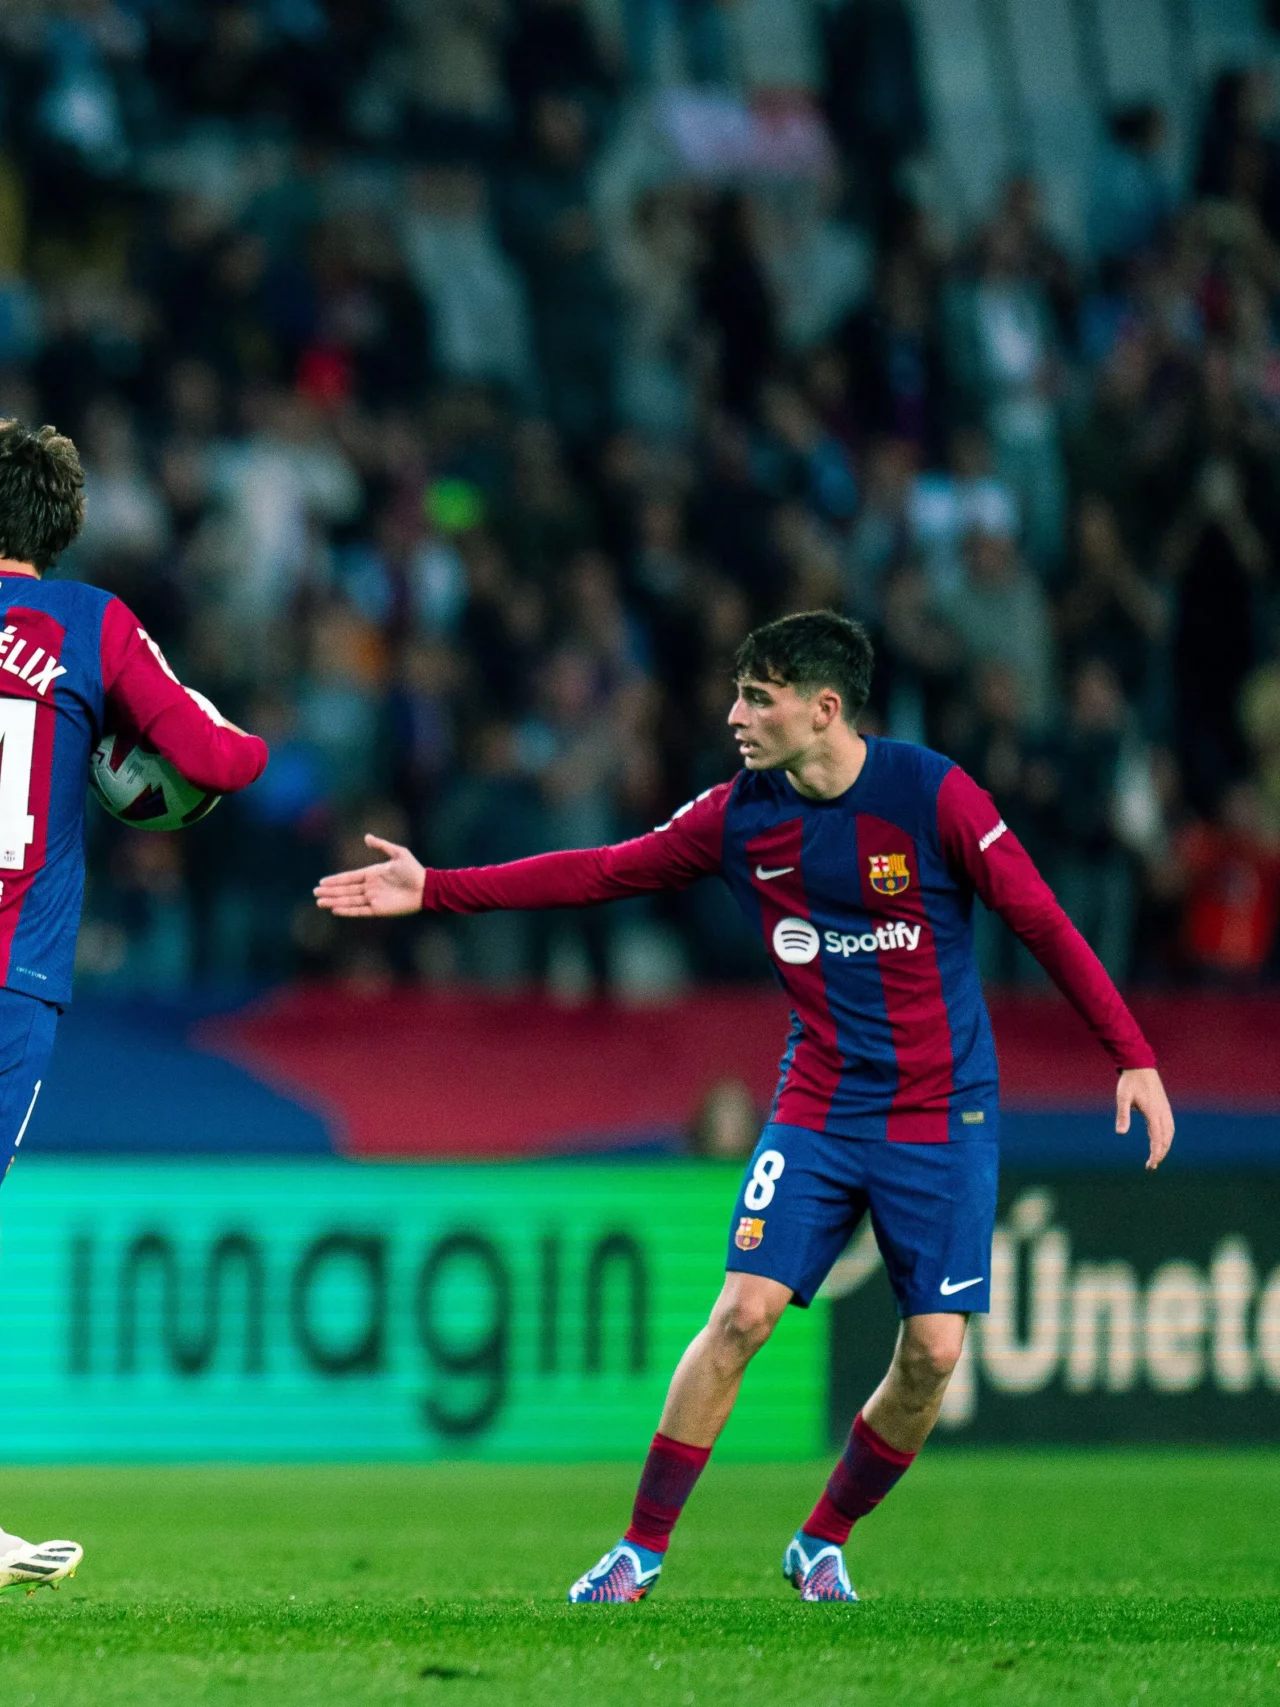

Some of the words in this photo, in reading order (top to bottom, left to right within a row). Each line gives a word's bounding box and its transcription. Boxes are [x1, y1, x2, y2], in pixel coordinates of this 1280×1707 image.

[824, 921, 921, 958] Spotify
[744, 1149, 786, 1211] 8
[65, 1227, 650, 1440] imagin
